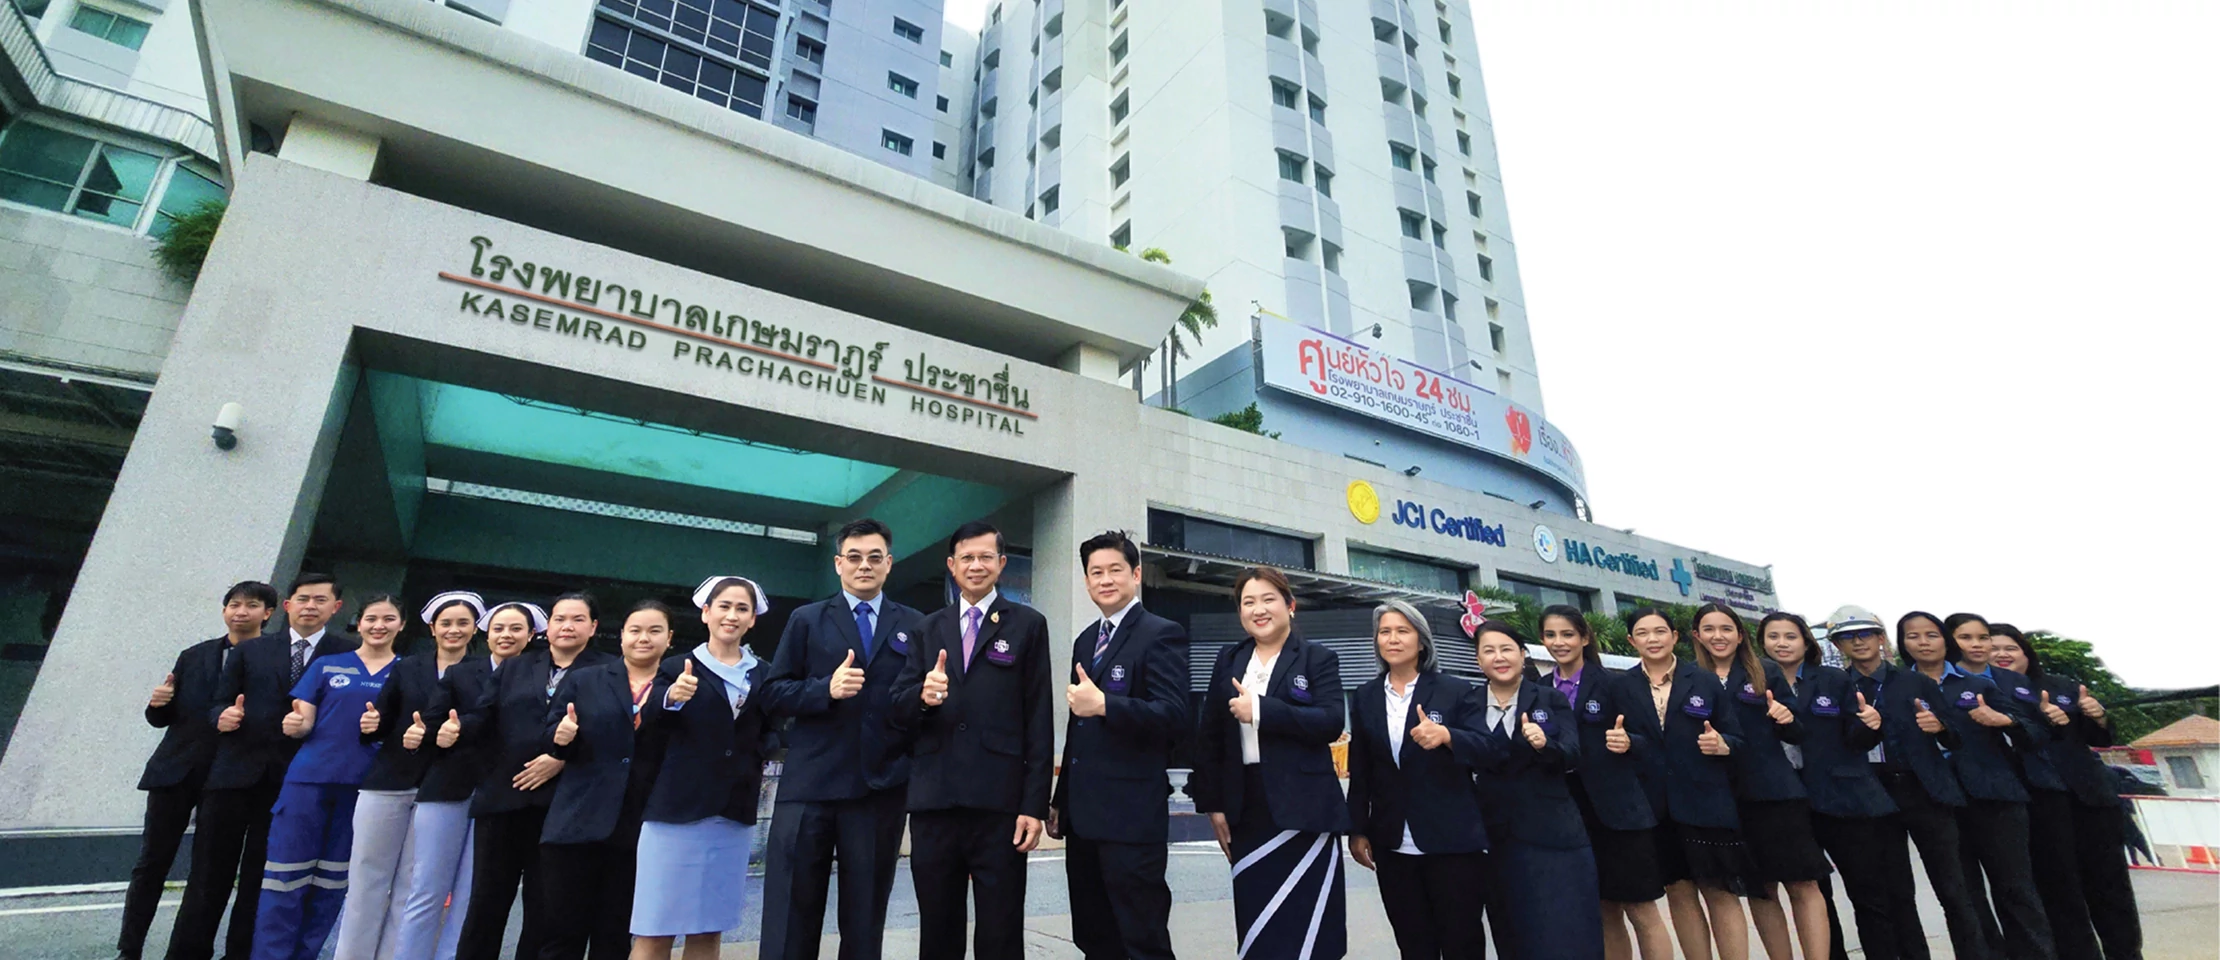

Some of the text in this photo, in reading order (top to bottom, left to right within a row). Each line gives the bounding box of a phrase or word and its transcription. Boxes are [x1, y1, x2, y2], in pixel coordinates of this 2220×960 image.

[460, 291, 1025, 435] KASEMRAD PRACHACHUEN HOSPITAL
[904, 352, 1030, 410] ประชาชื่น
[1298, 339, 1477, 416] ศูนย์หัวใจ 24 ชม.
[1330, 385, 1430, 425] 02-910-1600-45
[1443, 420, 1481, 441] 1080-1
[1391, 499, 1507, 548] JCI Certified
[1563, 538, 1594, 567] HA
[1593, 546, 1660, 581] Certified
